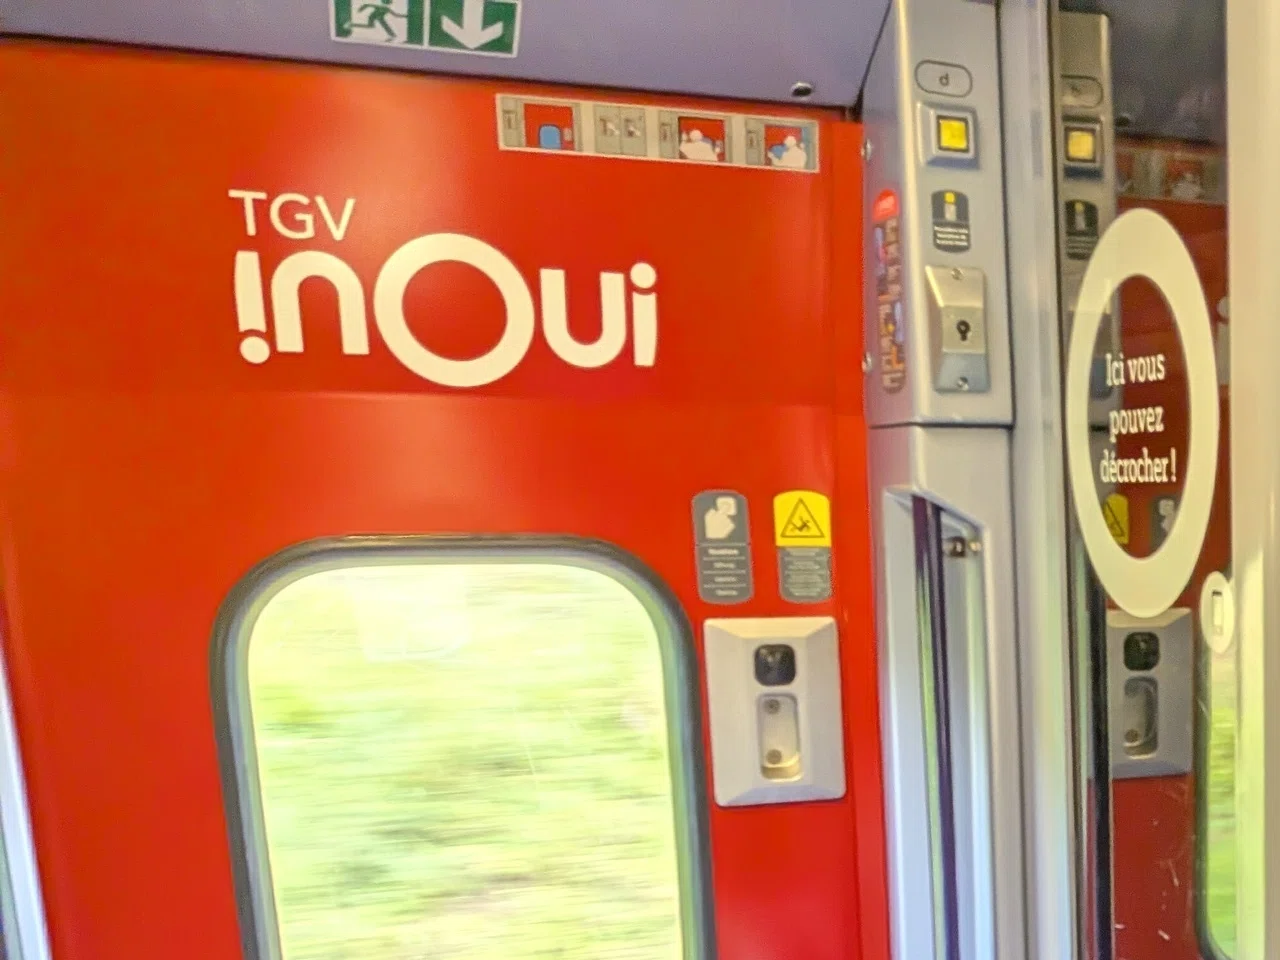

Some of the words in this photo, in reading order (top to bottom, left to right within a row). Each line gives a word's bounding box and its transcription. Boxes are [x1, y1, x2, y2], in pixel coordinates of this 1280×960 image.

[228, 189, 356, 241] TGV
[1105, 352, 1126, 387] Ici
[1127, 353, 1165, 384] vous
[1109, 406, 1164, 443] pouvez
